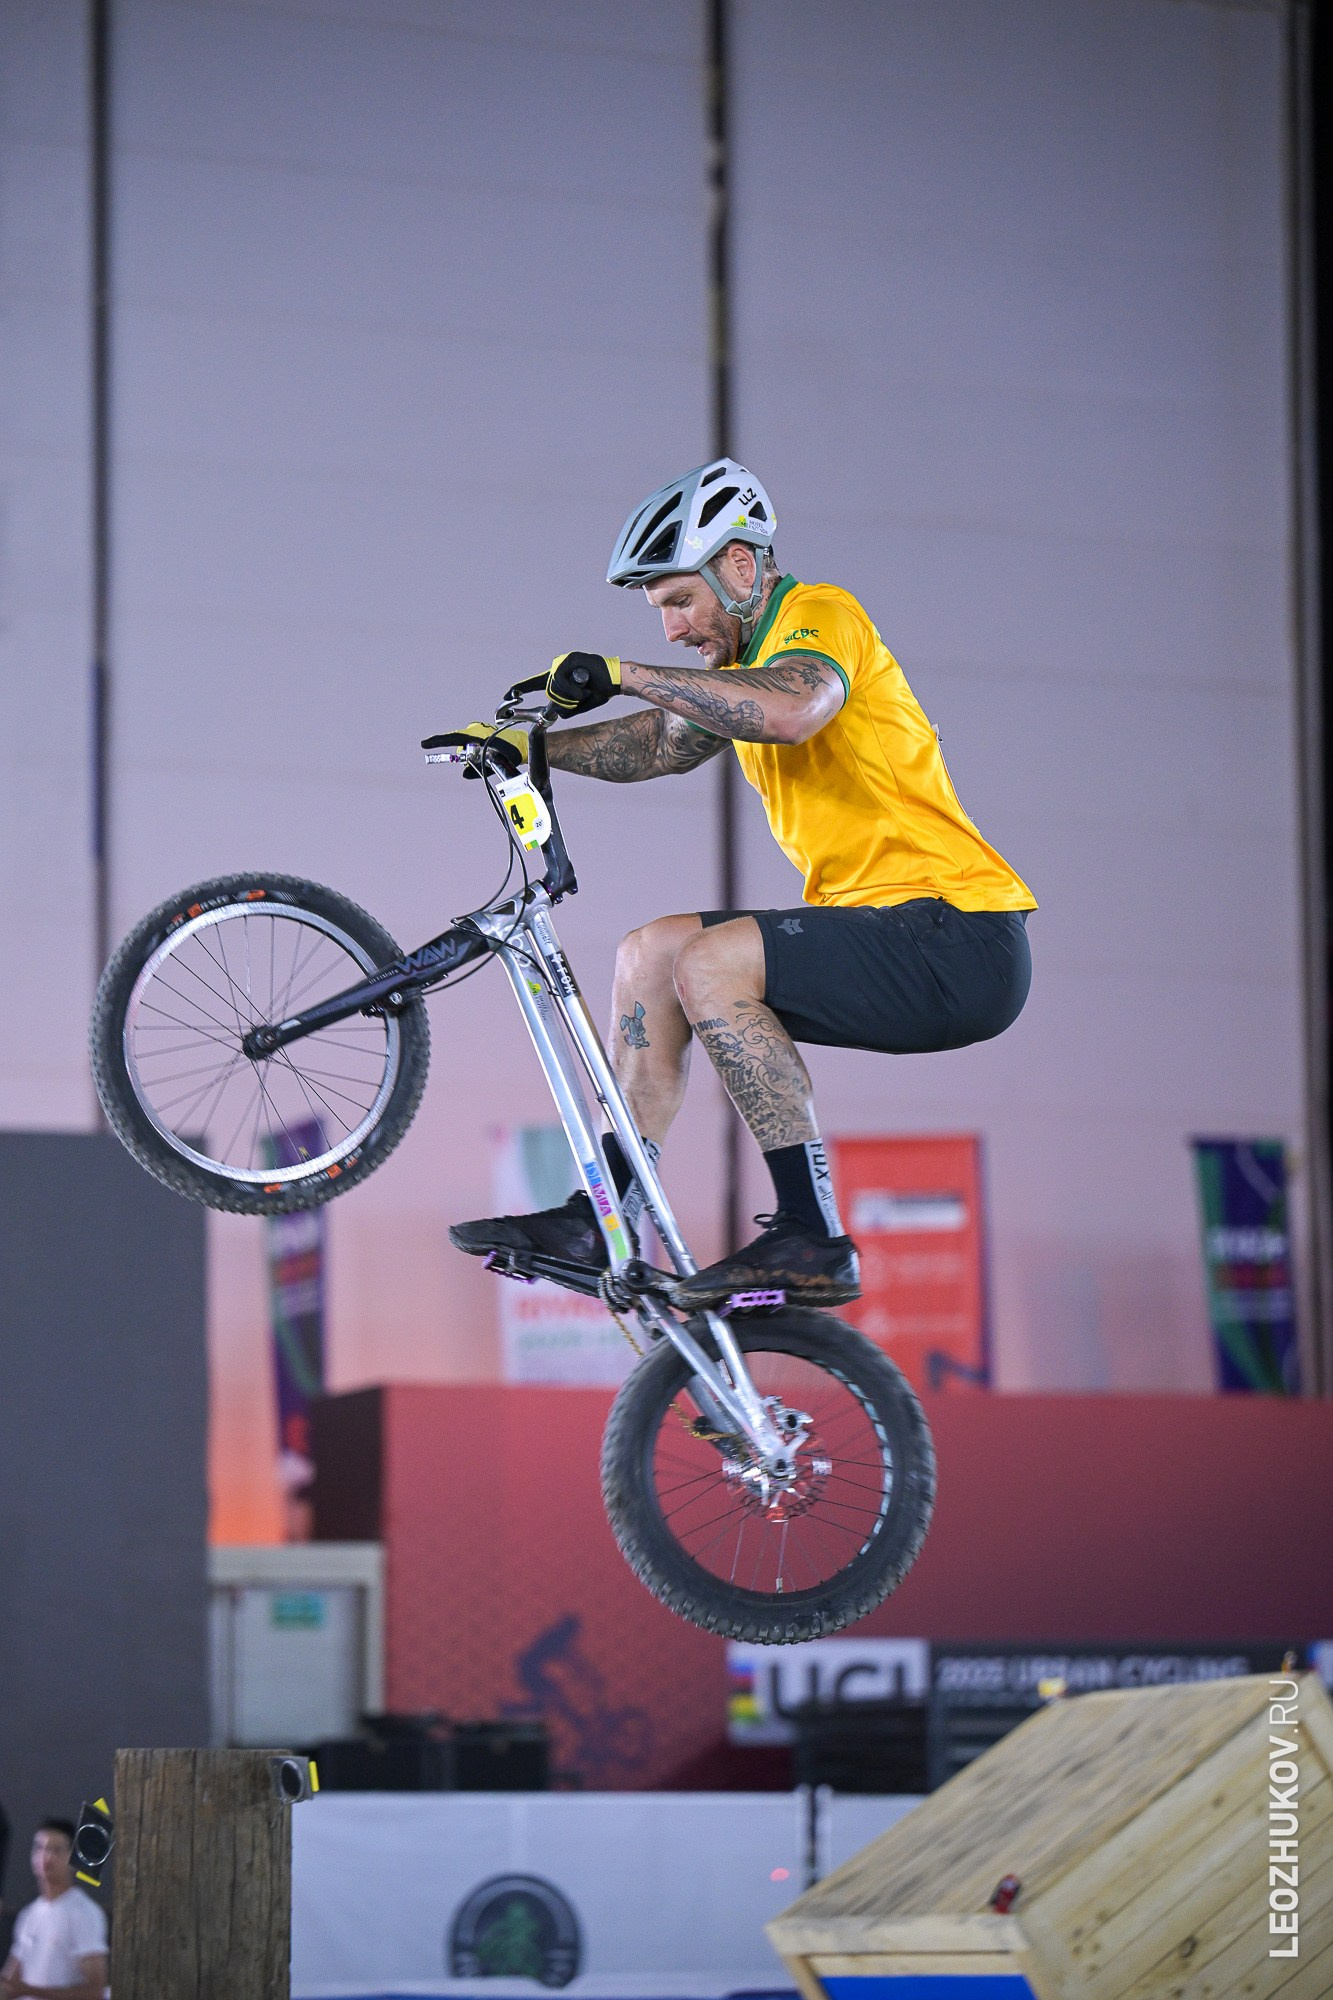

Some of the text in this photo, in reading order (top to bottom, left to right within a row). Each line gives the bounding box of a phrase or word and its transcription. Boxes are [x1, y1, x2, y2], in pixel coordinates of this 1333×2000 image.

[510, 804, 525, 830] 4
[557, 966, 577, 995] FOX
[768, 1660, 905, 1720] UCI
